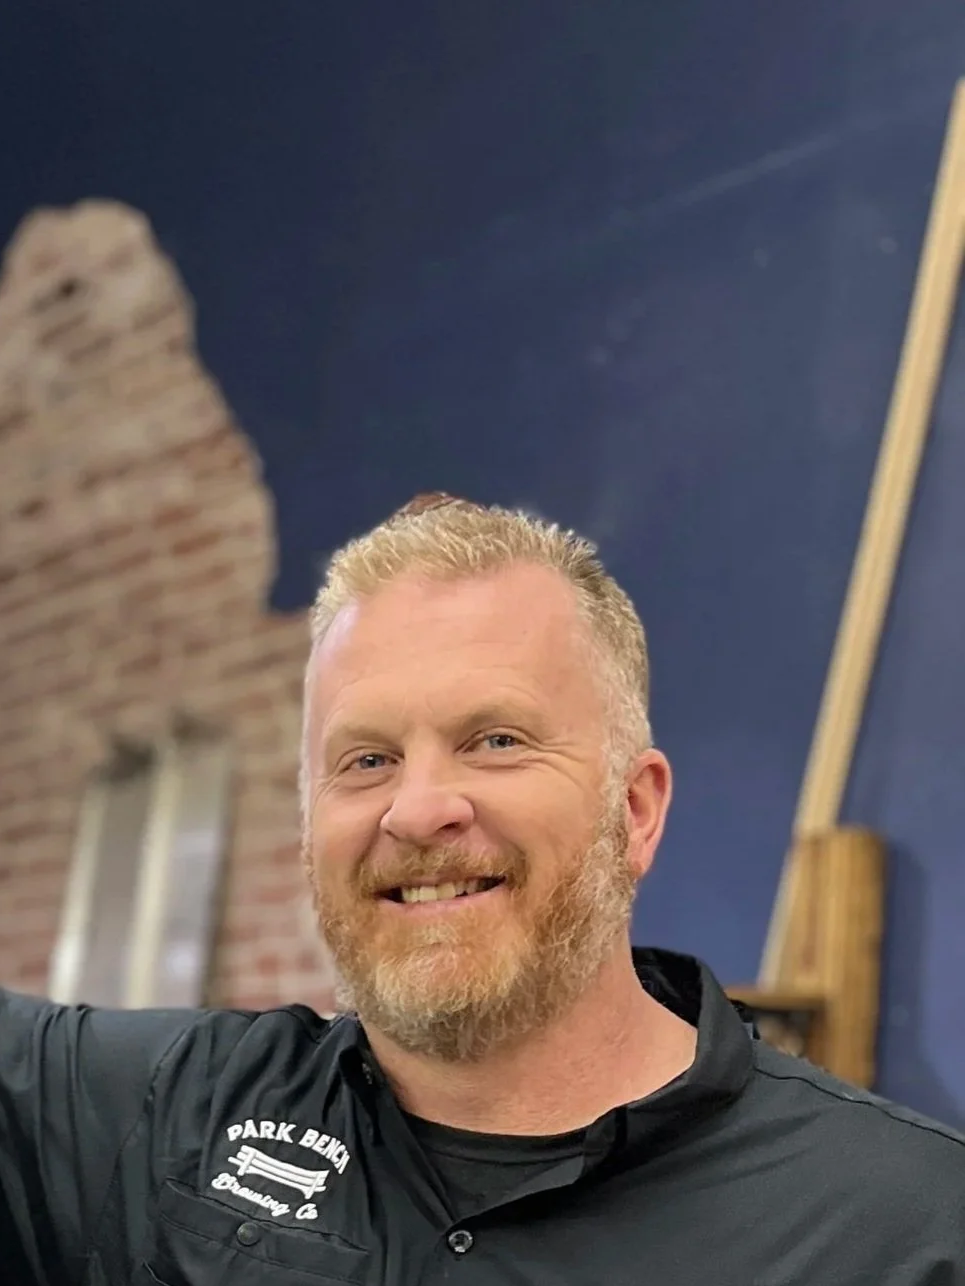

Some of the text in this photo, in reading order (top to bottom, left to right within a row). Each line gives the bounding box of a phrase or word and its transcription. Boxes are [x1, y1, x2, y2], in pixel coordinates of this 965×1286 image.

[227, 1119, 350, 1174] PARK BENCH
[211, 1173, 290, 1217] Brewing
